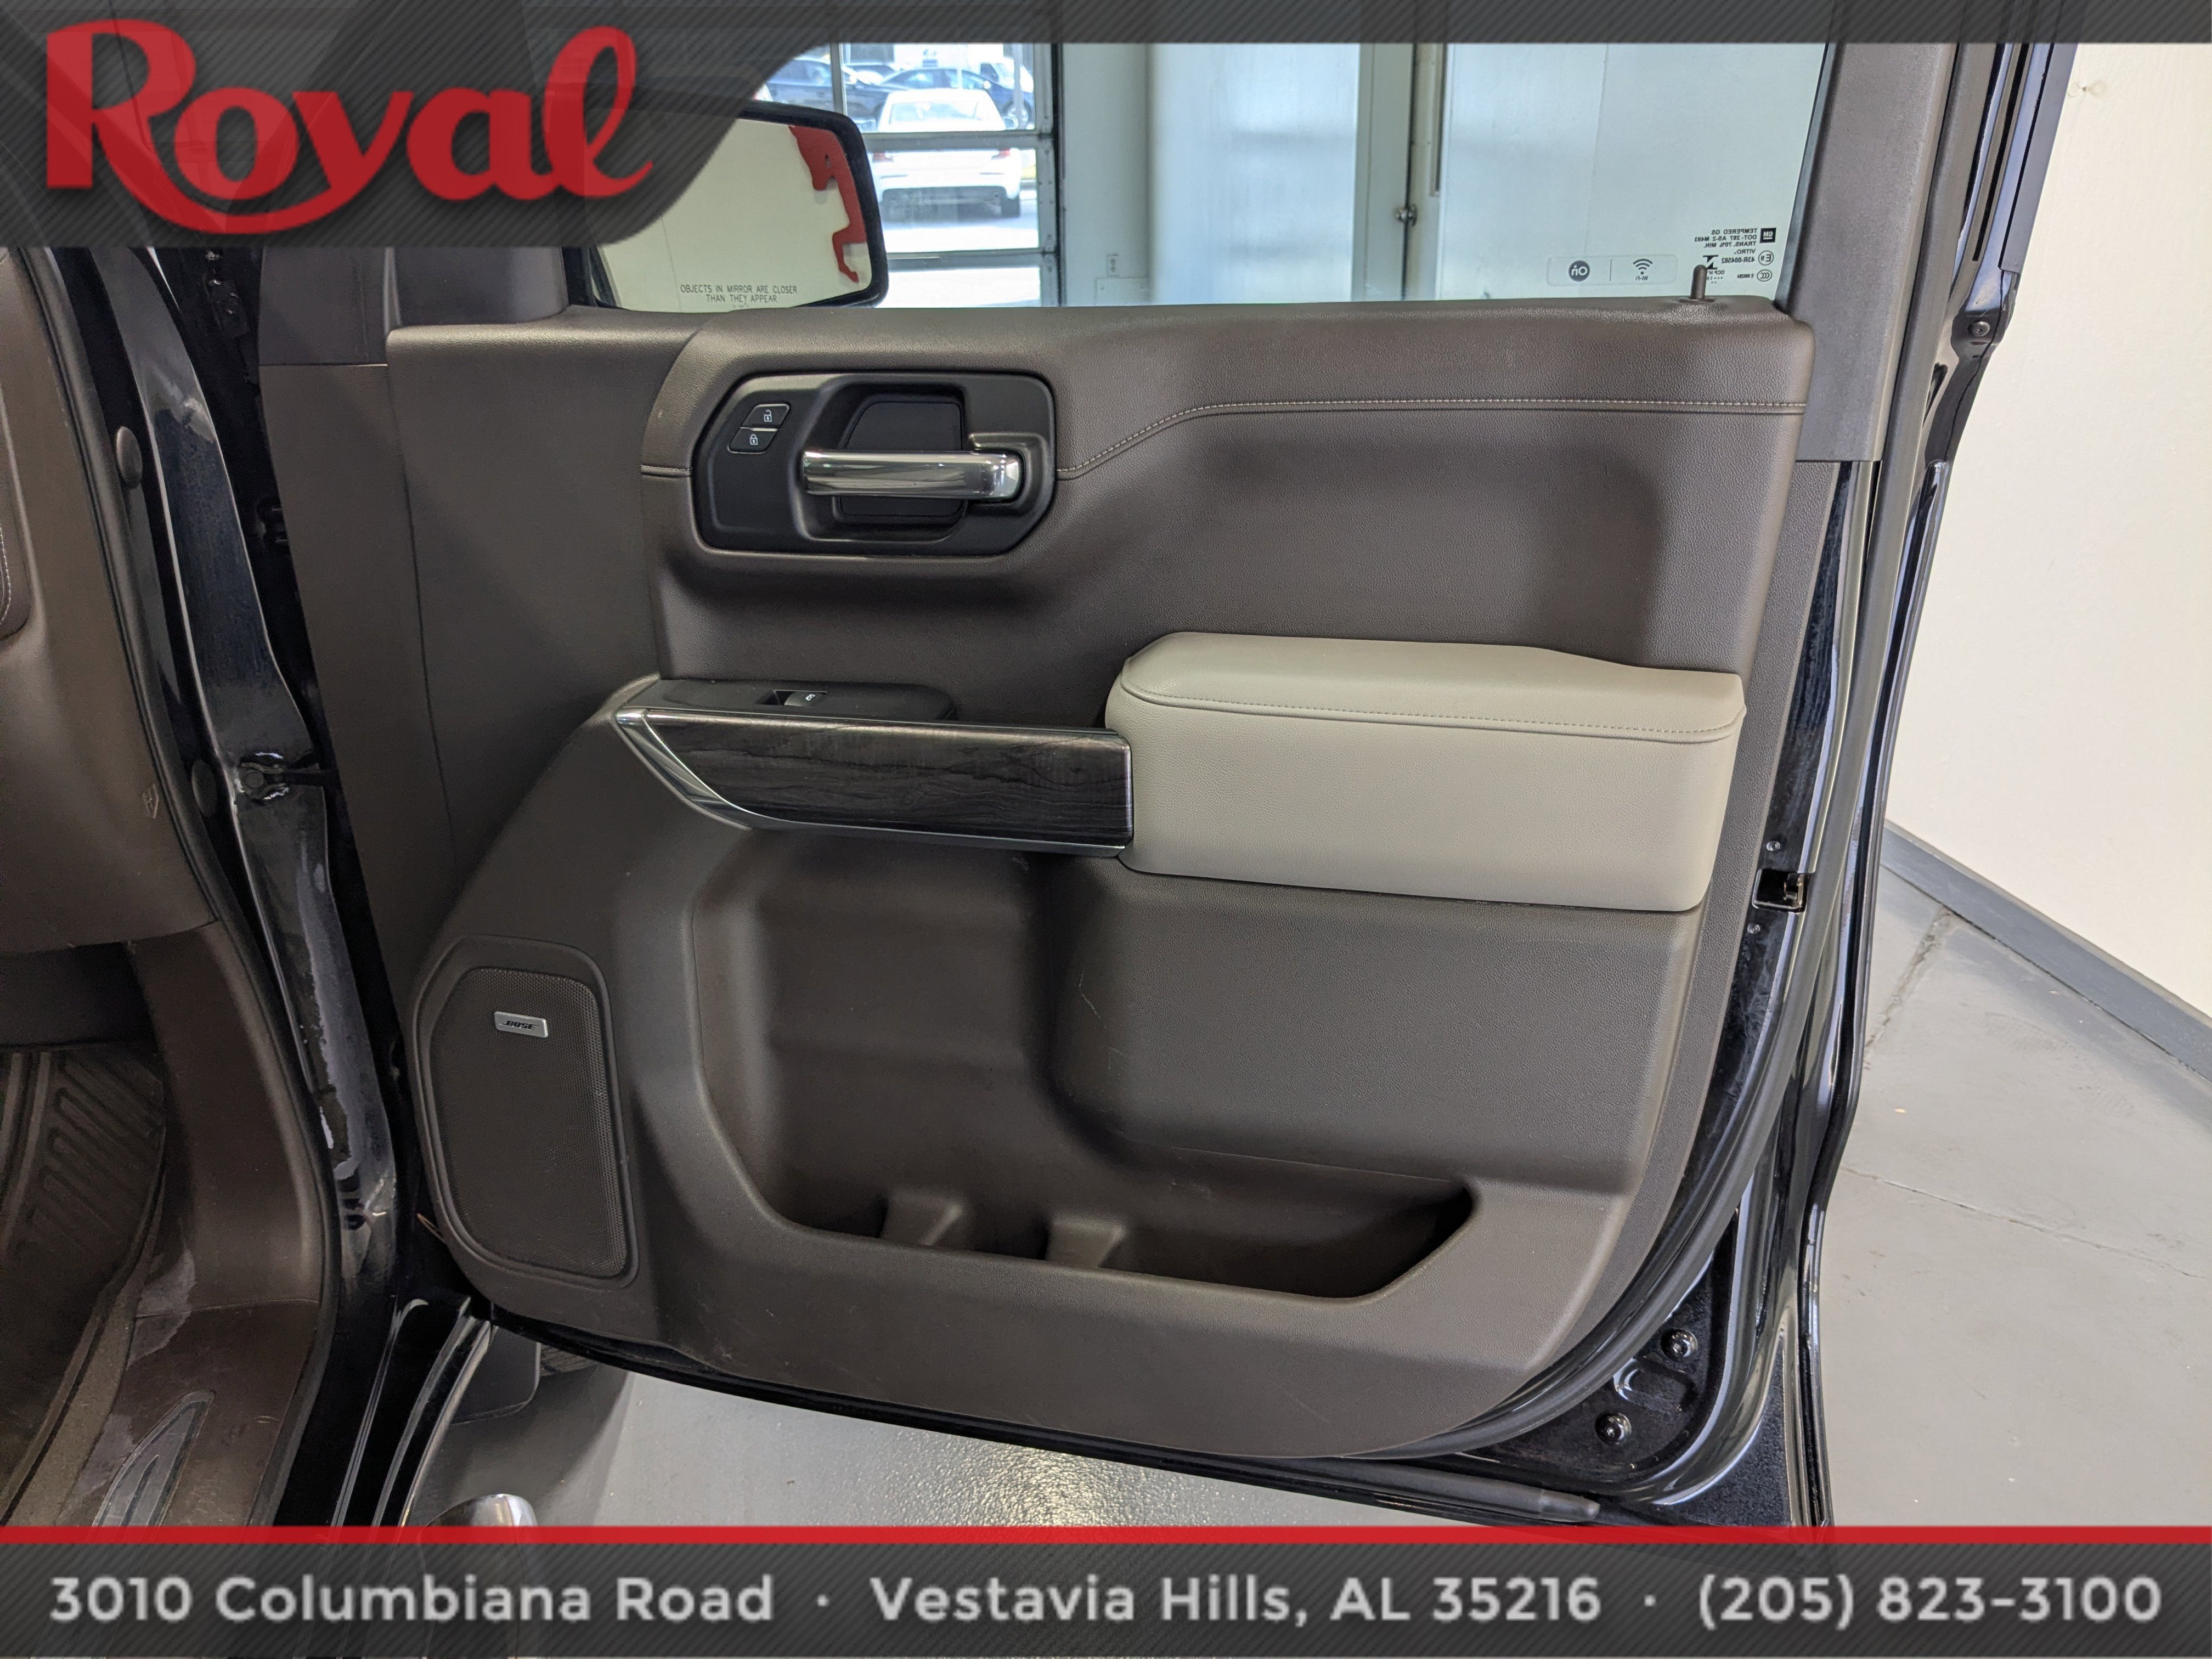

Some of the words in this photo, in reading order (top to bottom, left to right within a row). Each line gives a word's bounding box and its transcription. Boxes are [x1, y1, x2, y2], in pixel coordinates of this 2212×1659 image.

[680, 284, 713, 294] OBJECTS
[715, 285, 723, 293] IN
[727, 285, 753, 294] MIRROR
[757, 285, 769, 294] ARE
[773, 285, 798, 294] CLOSER
[706, 294, 725, 302] THAN
[730, 294, 748, 303] THEY
[751, 294, 777, 303] APPEAR
[502, 1020, 539, 1030] BOSE
